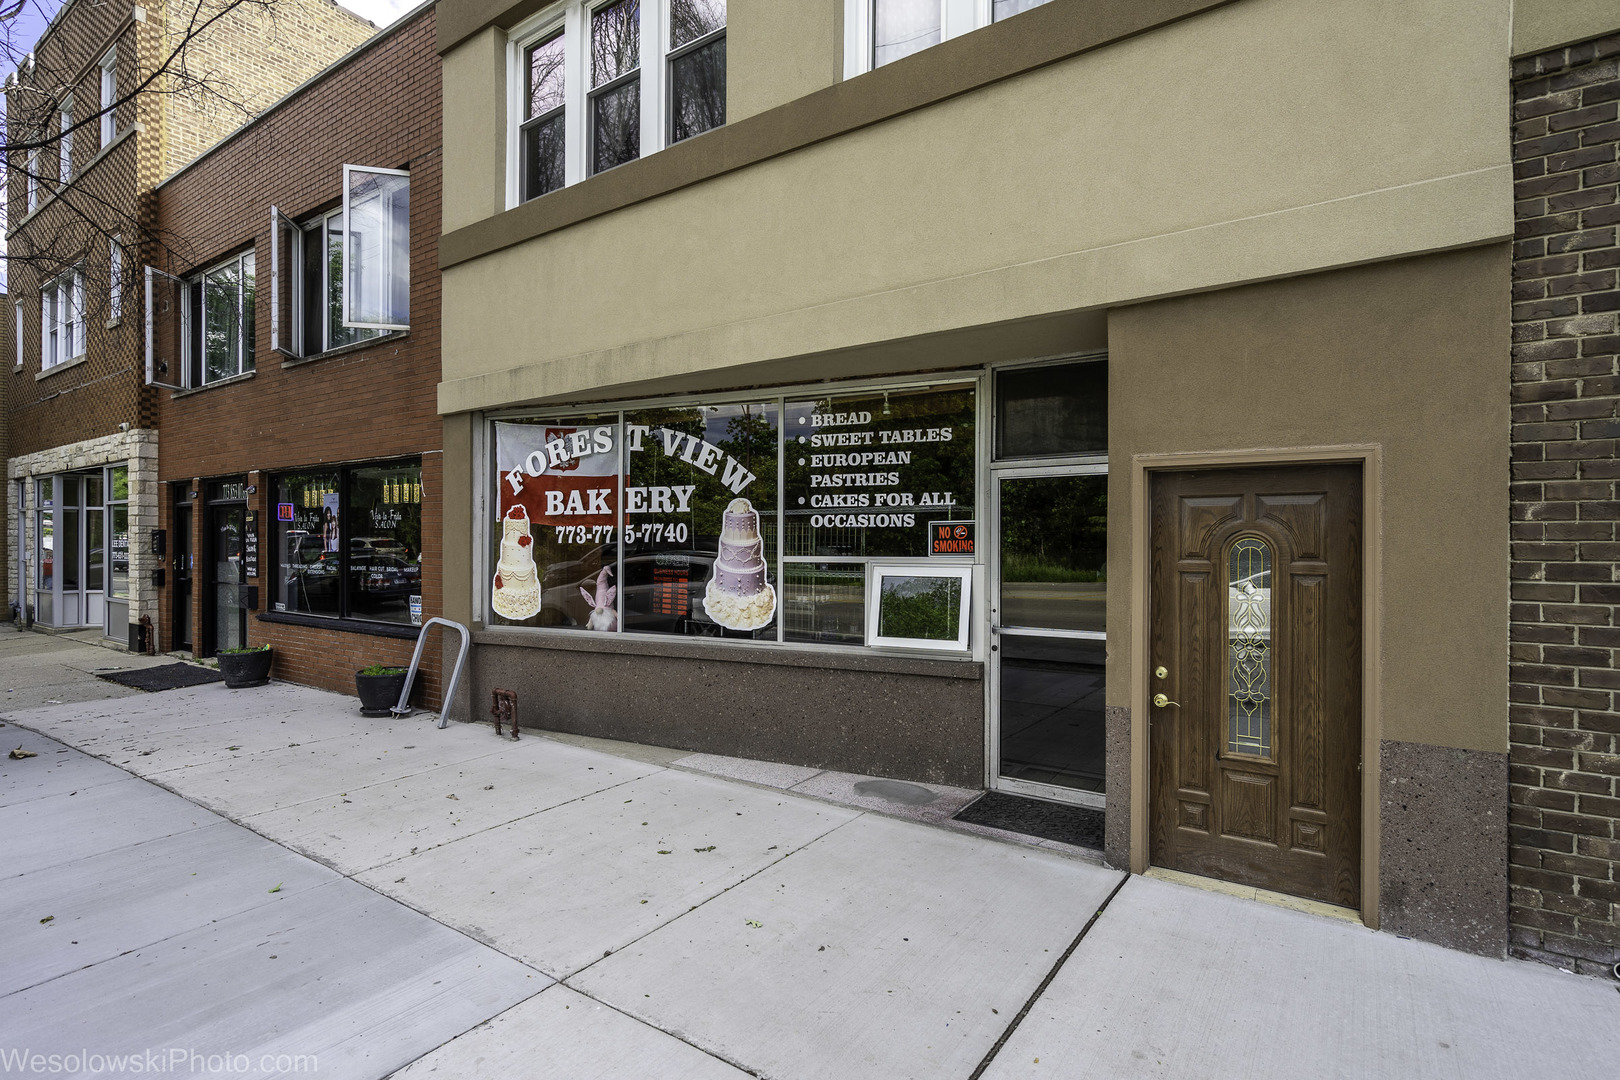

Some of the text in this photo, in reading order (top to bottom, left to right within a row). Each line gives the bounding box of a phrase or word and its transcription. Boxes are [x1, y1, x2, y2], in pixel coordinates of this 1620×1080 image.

[811, 411, 872, 427] BREAD
[811, 427, 953, 448] SWEET TABLES
[505, 425, 757, 497] FOREST VIEW
[810, 451, 912, 468] EUROPEAN
[810, 472, 900, 488] PASTRIES
[545, 485, 696, 516] BAKERY
[810, 492, 956, 508] CAKES FOR ALL
[374, 519, 398, 529] SALON
[810, 514, 916, 528] OCCASIONS
[555, 523, 688, 544] 773-775-7740
[938, 527, 951, 539] NO
[934, 540, 974, 553] SMOKING
